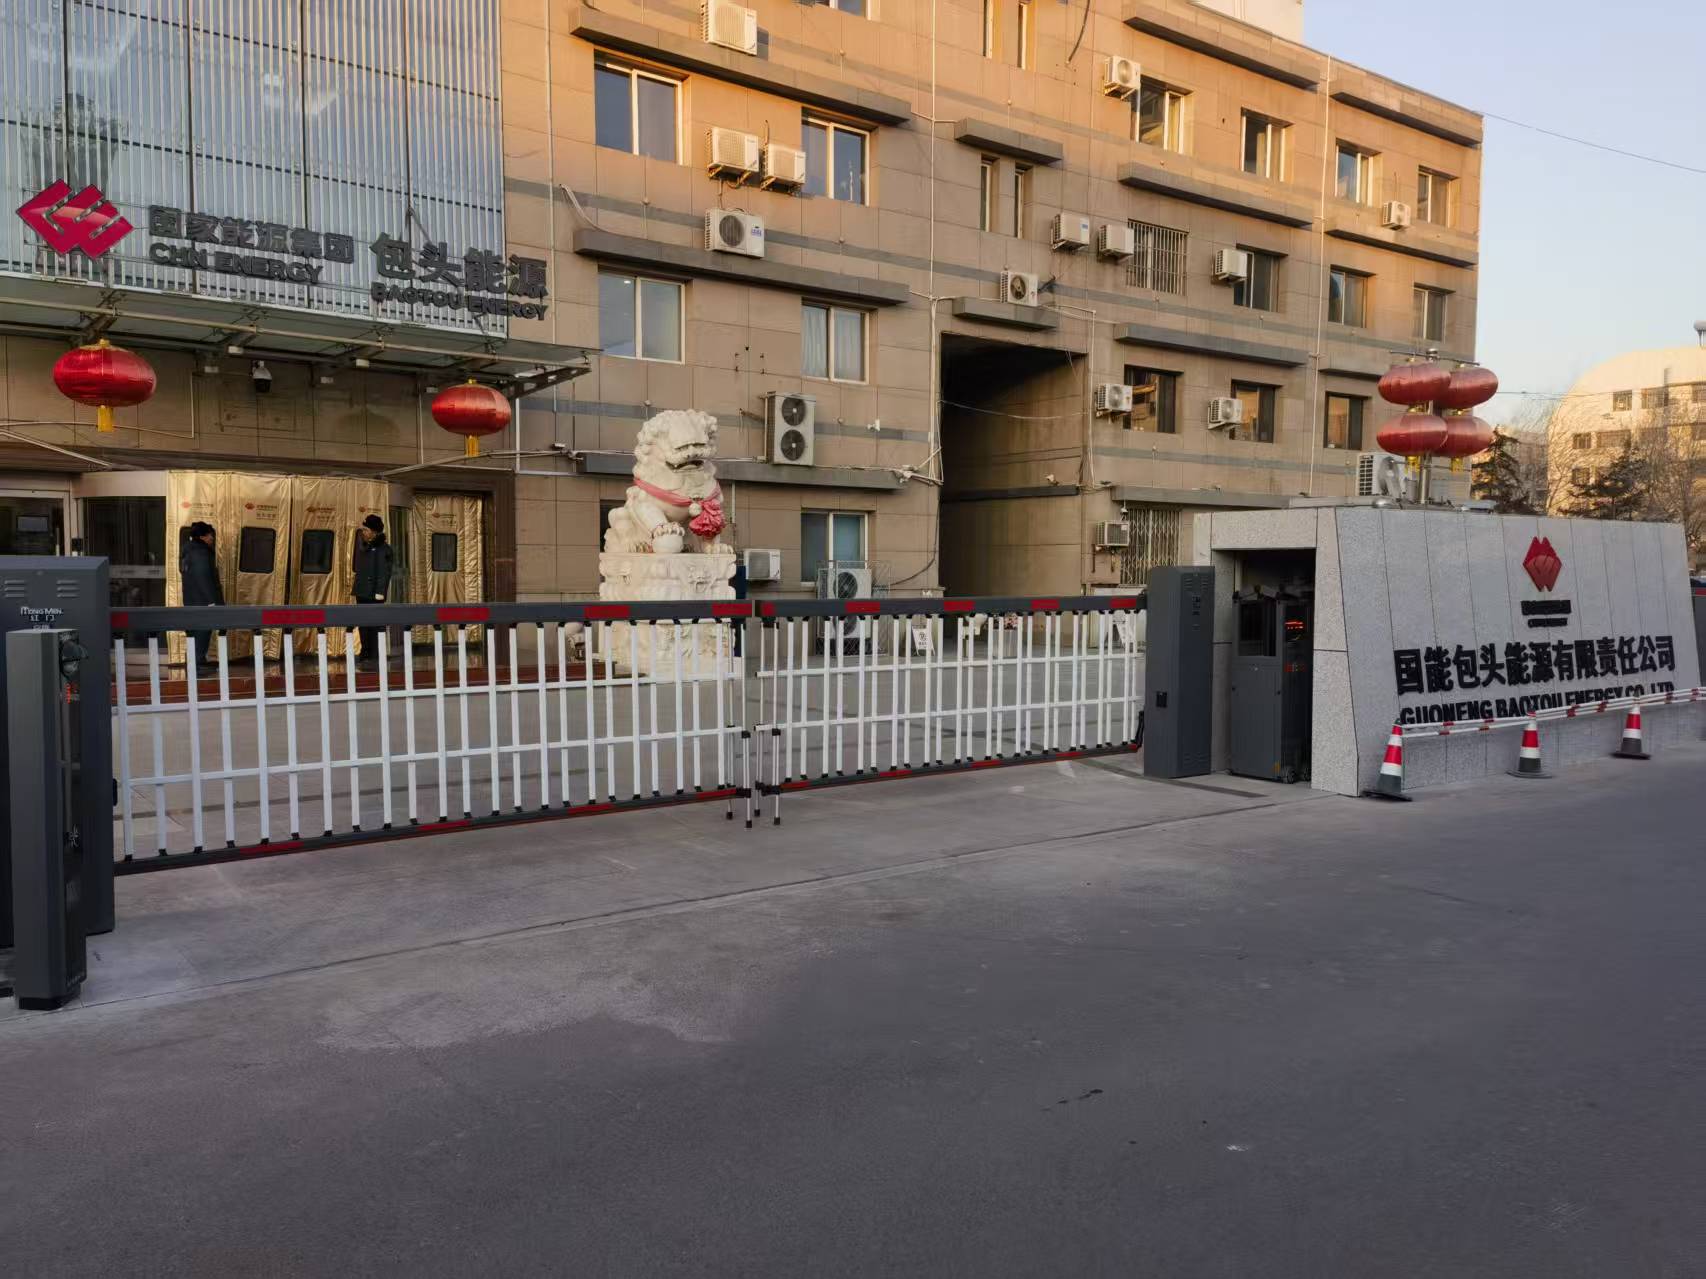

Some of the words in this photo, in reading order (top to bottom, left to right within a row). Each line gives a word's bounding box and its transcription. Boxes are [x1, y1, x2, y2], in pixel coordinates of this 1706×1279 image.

[149, 243, 208, 269] CHN
[214, 251, 323, 284] ENERGY
[370, 231, 548, 298] 包头能源
[371, 281, 463, 310] BAOTOU
[467, 295, 548, 320] ENERGY
[1394, 635, 1676, 696] 国能包头能源有限责任公司
[1400, 700, 1493, 725] GUONENG
[1495, 693, 1563, 717] BAOTOU
